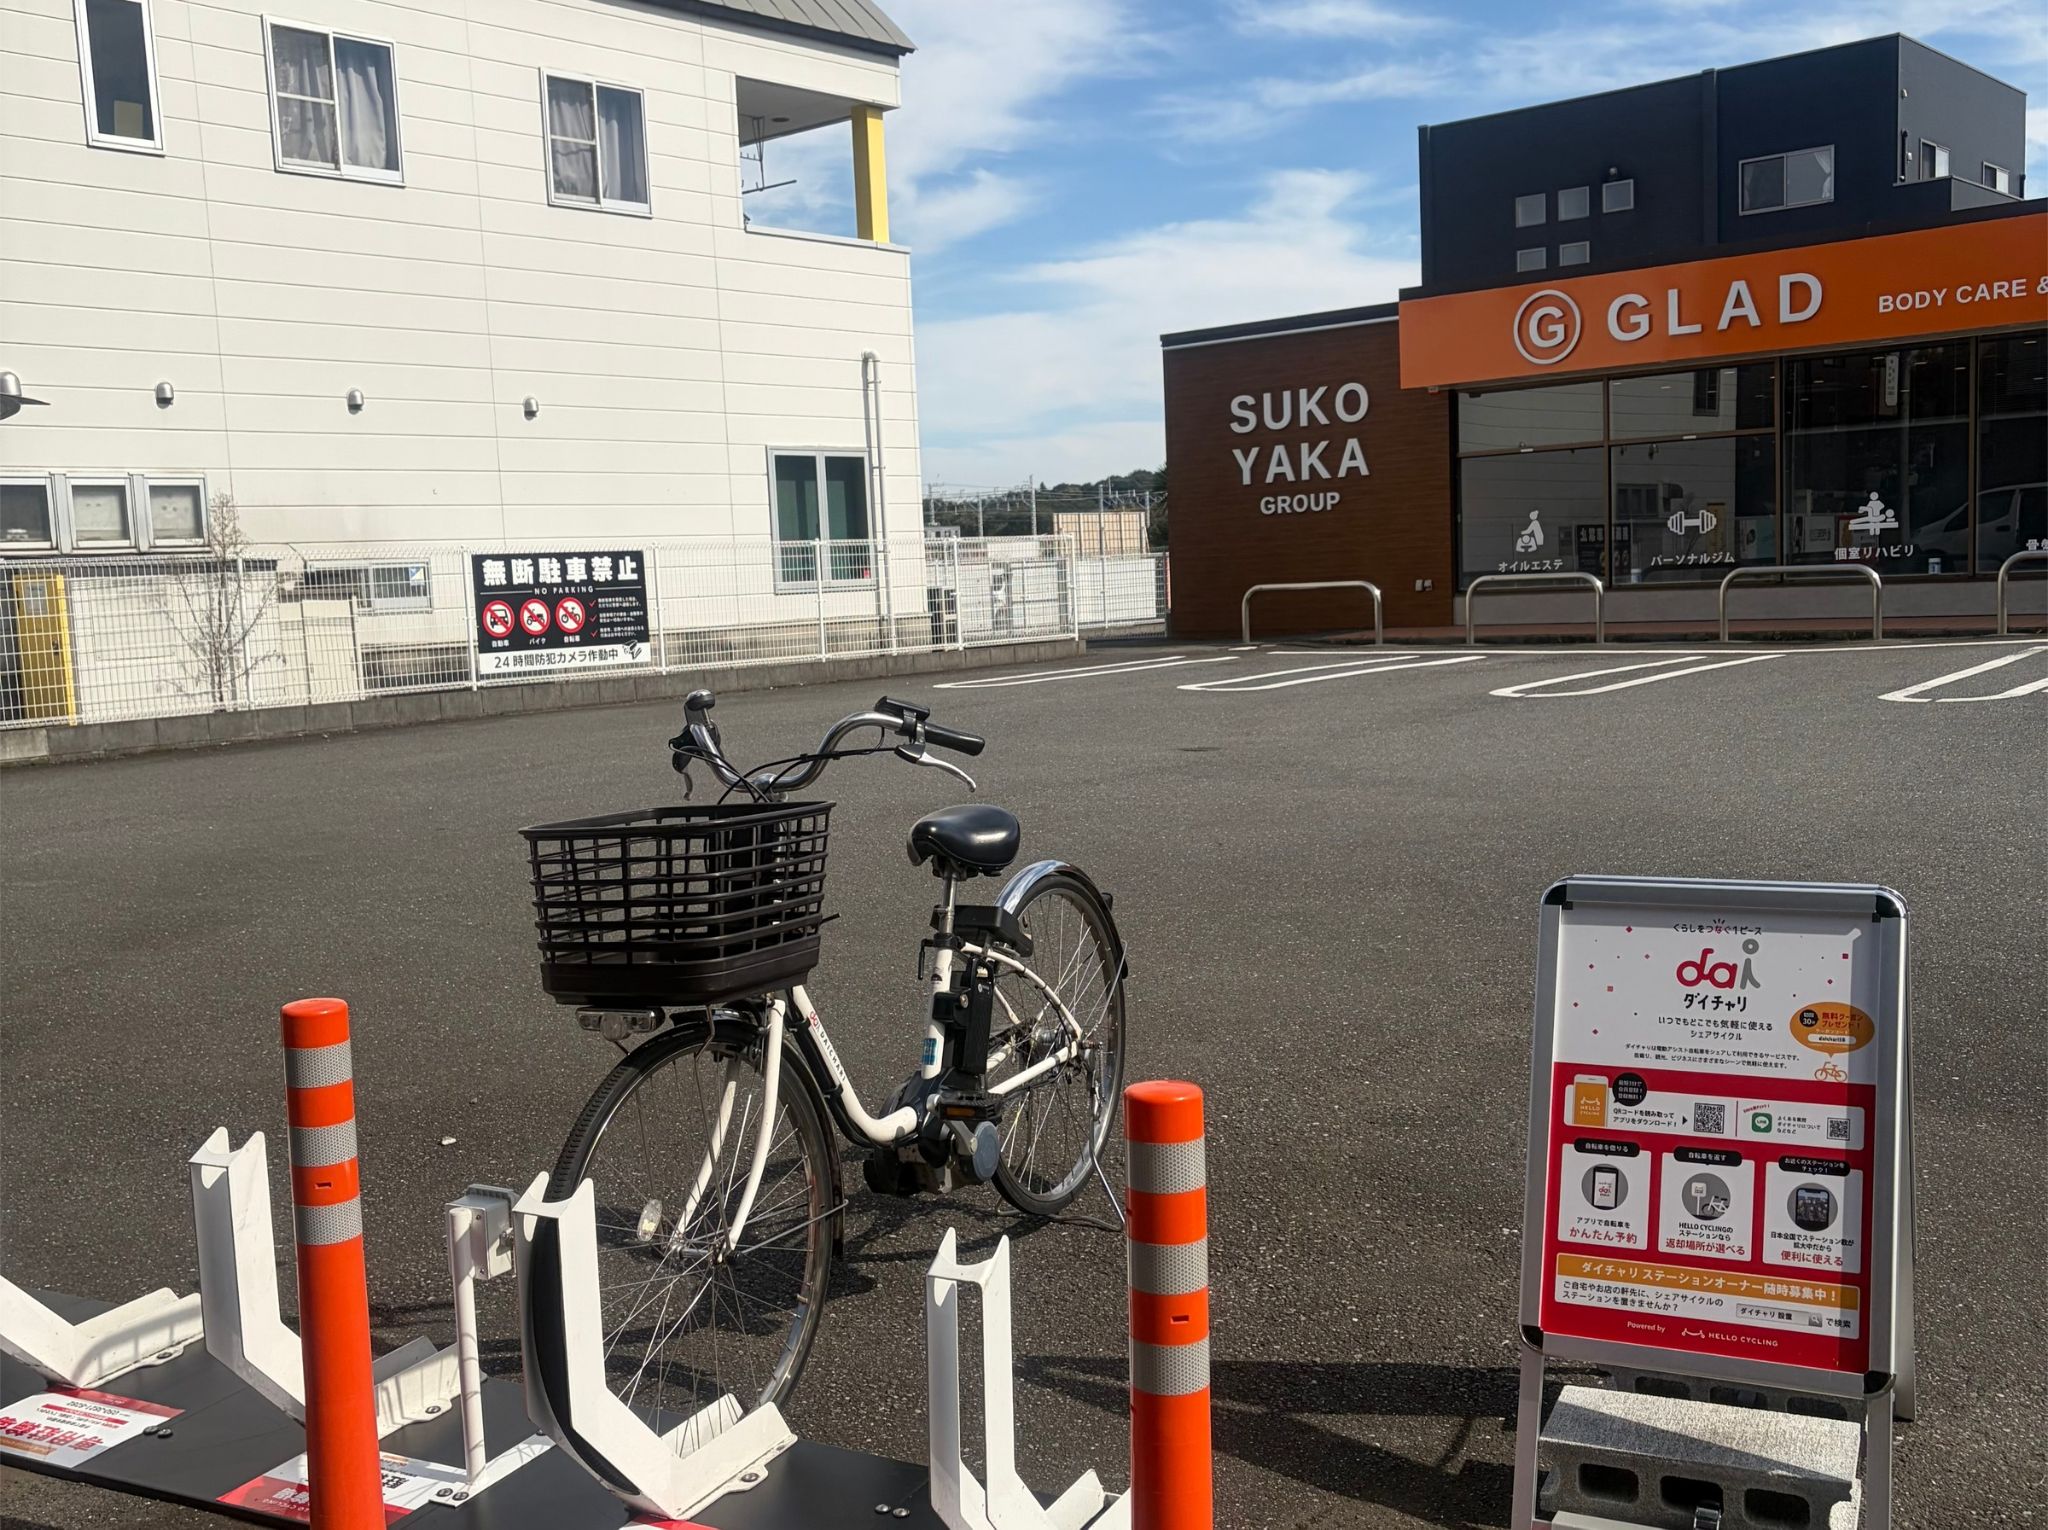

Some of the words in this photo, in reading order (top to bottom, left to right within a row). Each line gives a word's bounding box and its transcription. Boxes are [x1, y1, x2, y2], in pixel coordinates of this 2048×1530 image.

[1878, 286, 1949, 314] BODY
[1955, 277, 2027, 304] CARE
[1606, 271, 1824, 342] GLAD
[1229, 382, 1369, 434] SUKO
[1231, 438, 1370, 486] YAKA
[1260, 491, 1341, 515] GROUP
[1650, 552, 1735, 567] パーソナルジム
[1834, 544, 1915, 561] 個室リハビリ
[482, 556, 639, 586] 無断駐車禁止
[1498, 558, 1564, 573] オイルエステ
[534, 587, 548, 595] NO
[553, 586, 594, 595] PARKING
[529, 637, 546, 645] バイク
[1676, 938, 1761, 990] dai
[1683, 993, 1747, 1012] ダイチャリ
[1658, 1016, 1773, 1031] いつでもどこでも気軽に使える
[1822, 1012, 1864, 1022] 無料クーポン
[1690, 1030, 1742, 1041] シェアサイクル
[1613, 1108, 1675, 1119] QRコードを読み取って
[1585, 1142, 1629, 1153] 自転車を借りる
[1688, 1152, 1727, 1161] 自転車を返す
[1576, 1216, 1631, 1229] アプリで自転車を
[1679, 1222, 1699, 1230] HELLO
[1700, 1224, 1733, 1234] CYCLINGの
[1569, 1226, 1637, 1244] かんたん予約
[1679, 1229, 1731, 1241] ステーションなら
[1771, 1231, 1854, 1247] 日本全国でステーション数が
[1666, 1237, 1745, 1255] 返却場所が選べる
[1793, 1242, 1832, 1252] 拡大中だから
[1781, 1250, 1843, 1266] 便利に使える
[1562, 1291, 1678, 1311] ステーションを置きませんか？
[1563, 1280, 1724, 1307] ご自宅やお店の軒先に、シェアサイクルの
[1627, 1321, 1655, 1332] Powered
[1656, 1322, 1666, 1333] by
[1826, 1318, 1851, 1328] で検索
[1708, 1332, 1738, 1342] HELLO
[1740, 1336, 1779, 1347] CYCLING
